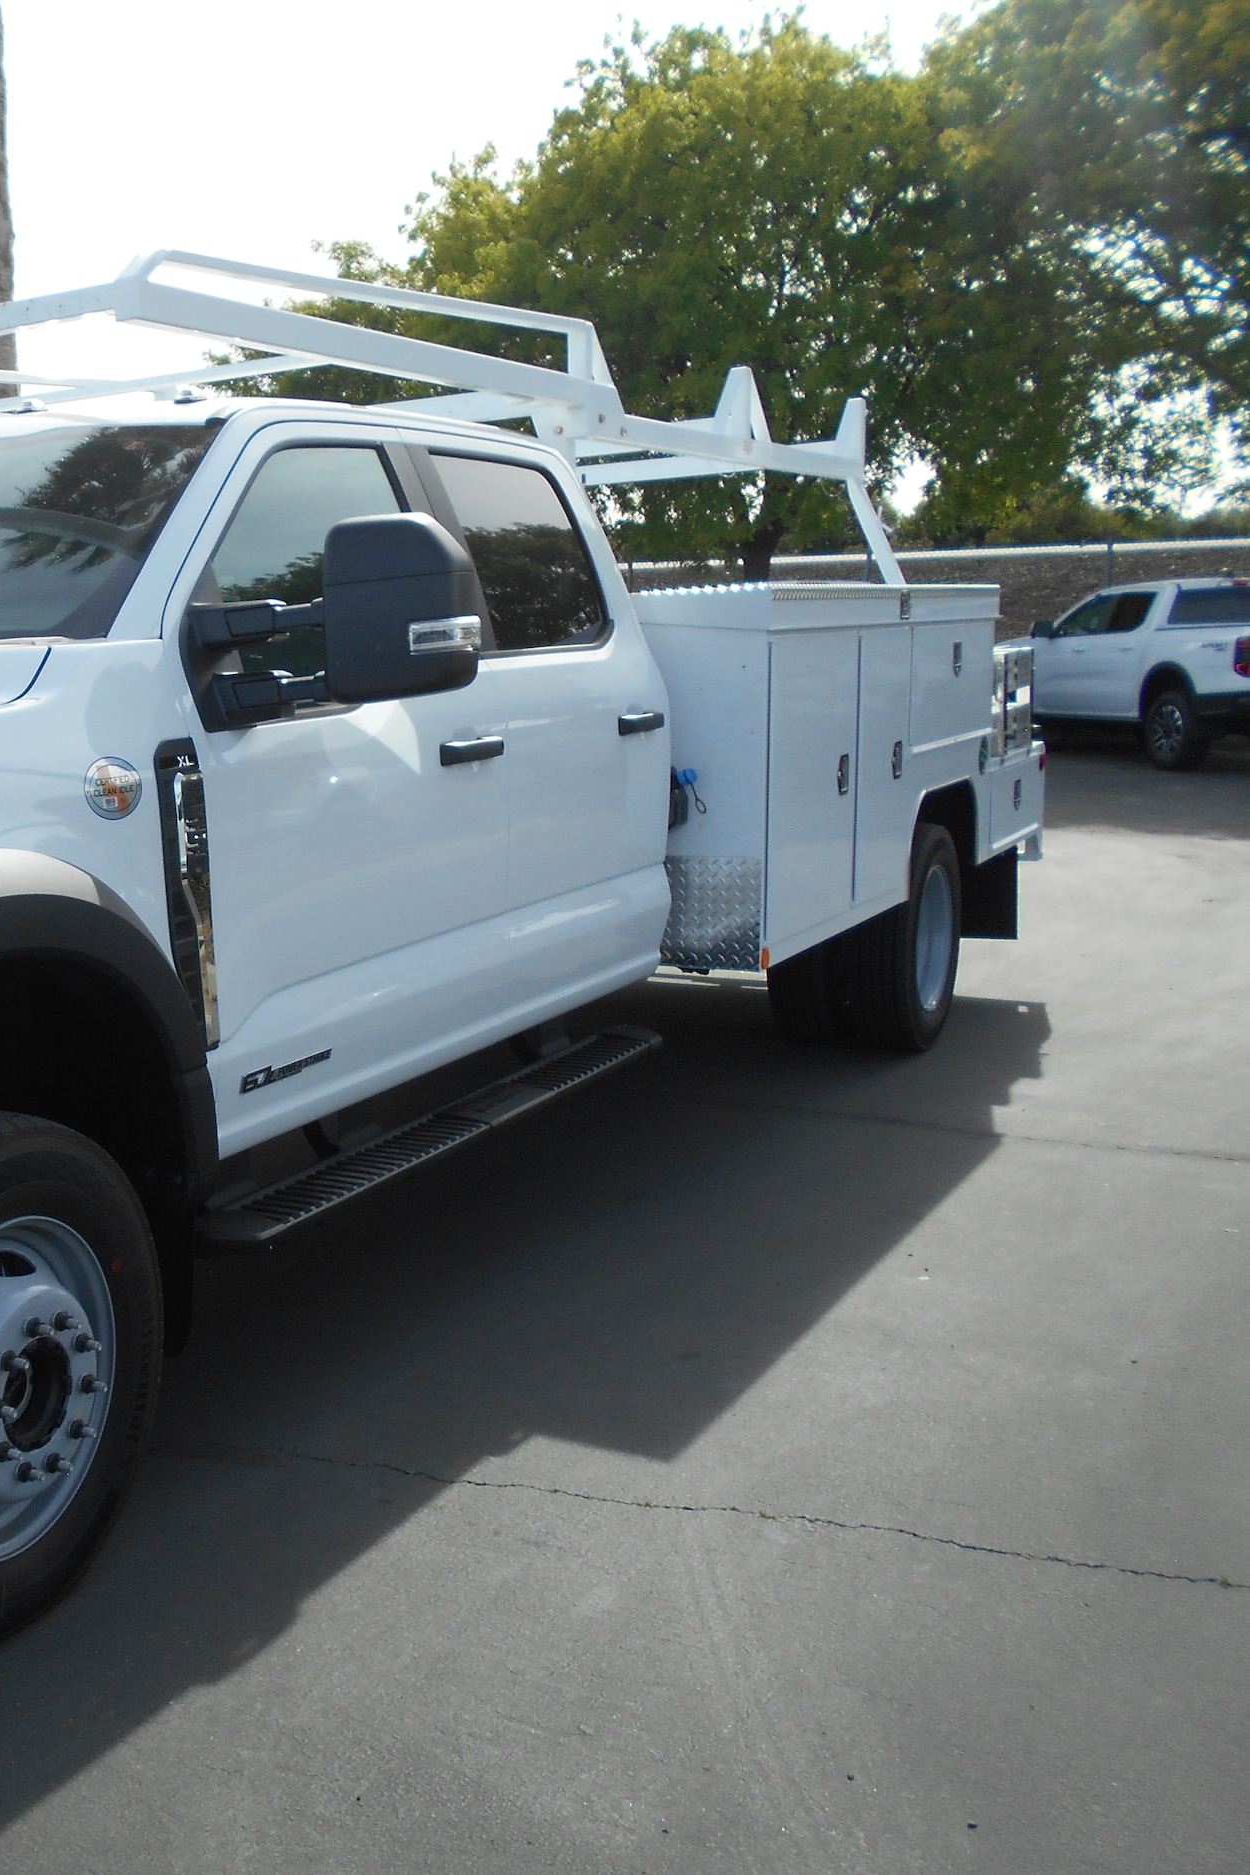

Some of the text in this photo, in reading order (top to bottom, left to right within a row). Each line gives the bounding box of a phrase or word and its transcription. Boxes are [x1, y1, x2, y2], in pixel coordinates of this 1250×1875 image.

[176, 755, 194, 768] XL
[95, 775, 129, 786] CERTIFIED
[94, 785, 134, 797] CLEAN IDLE
